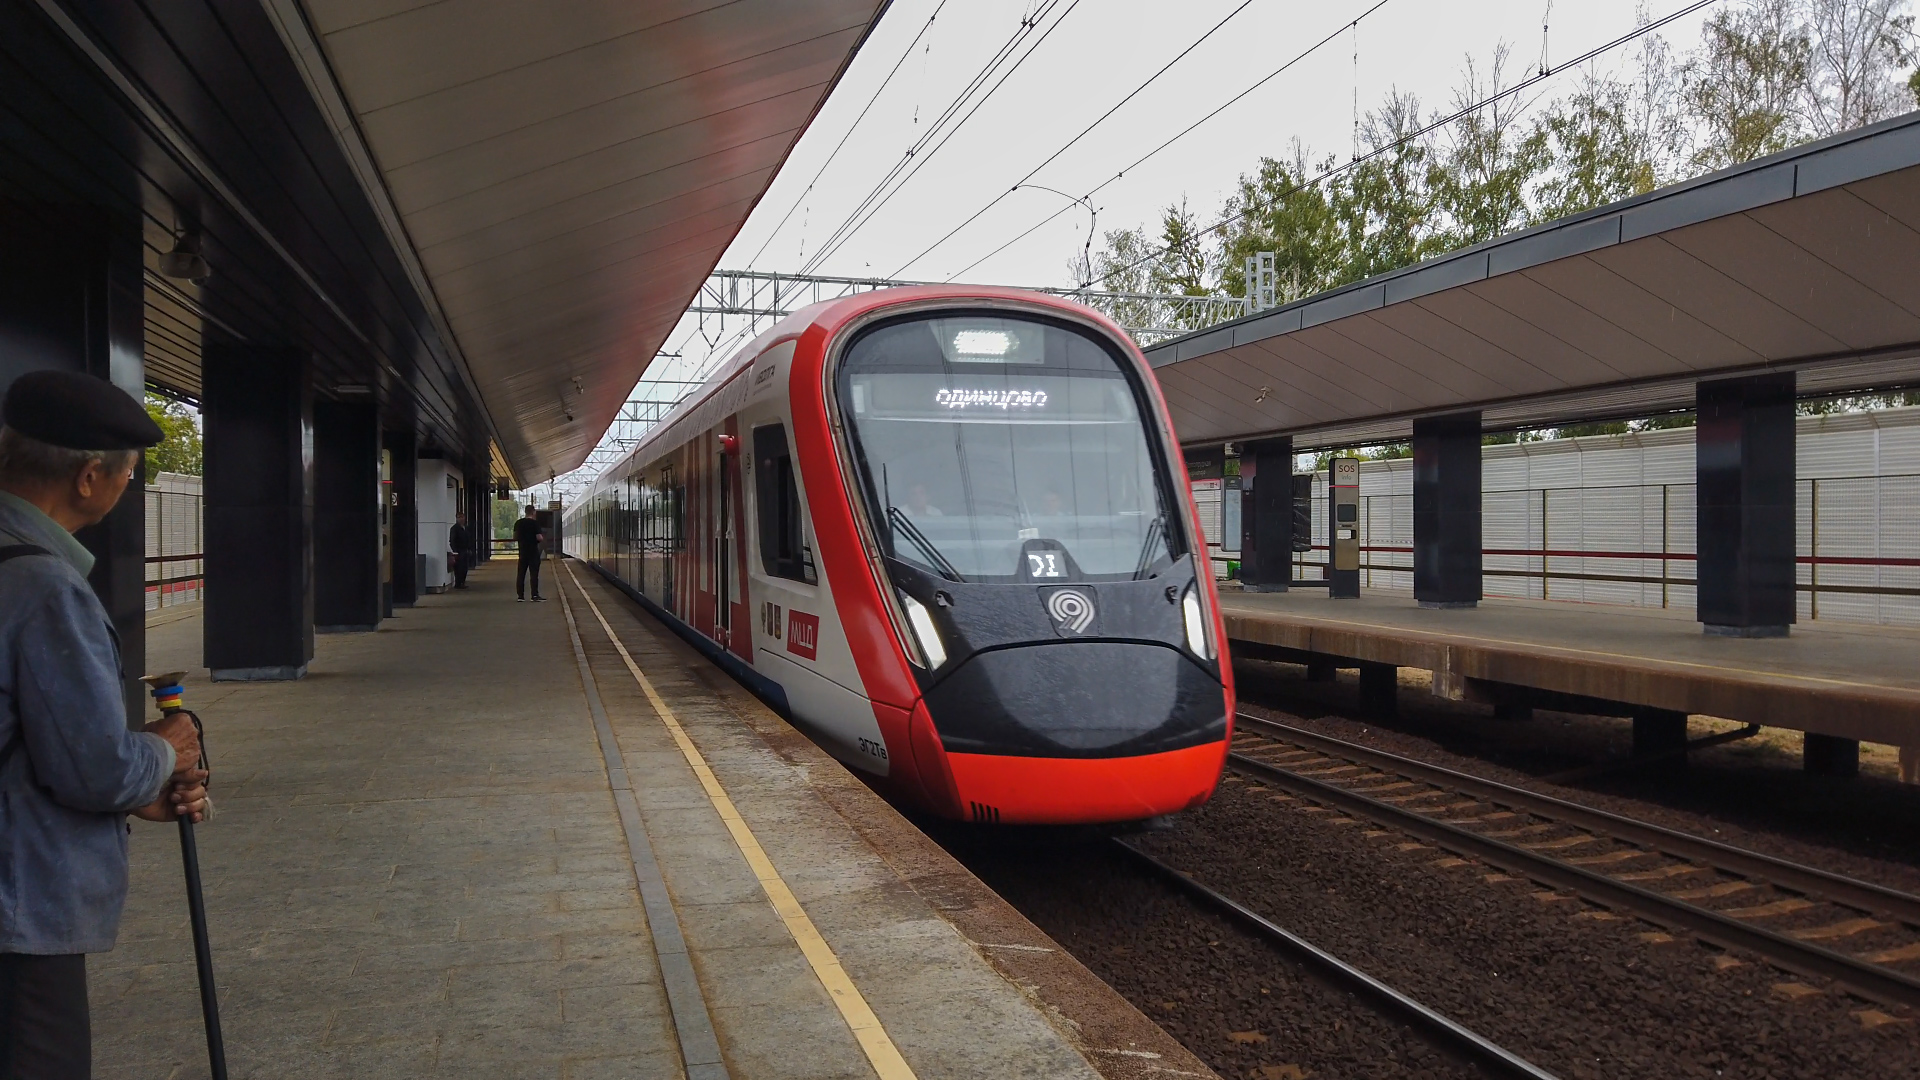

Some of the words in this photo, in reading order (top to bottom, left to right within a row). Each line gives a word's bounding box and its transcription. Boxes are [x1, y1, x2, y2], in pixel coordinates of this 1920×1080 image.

[936, 388, 1048, 410] ОДИНЦОВО
[1338, 464, 1355, 473] SOS
[790, 620, 814, 650] МЦД
